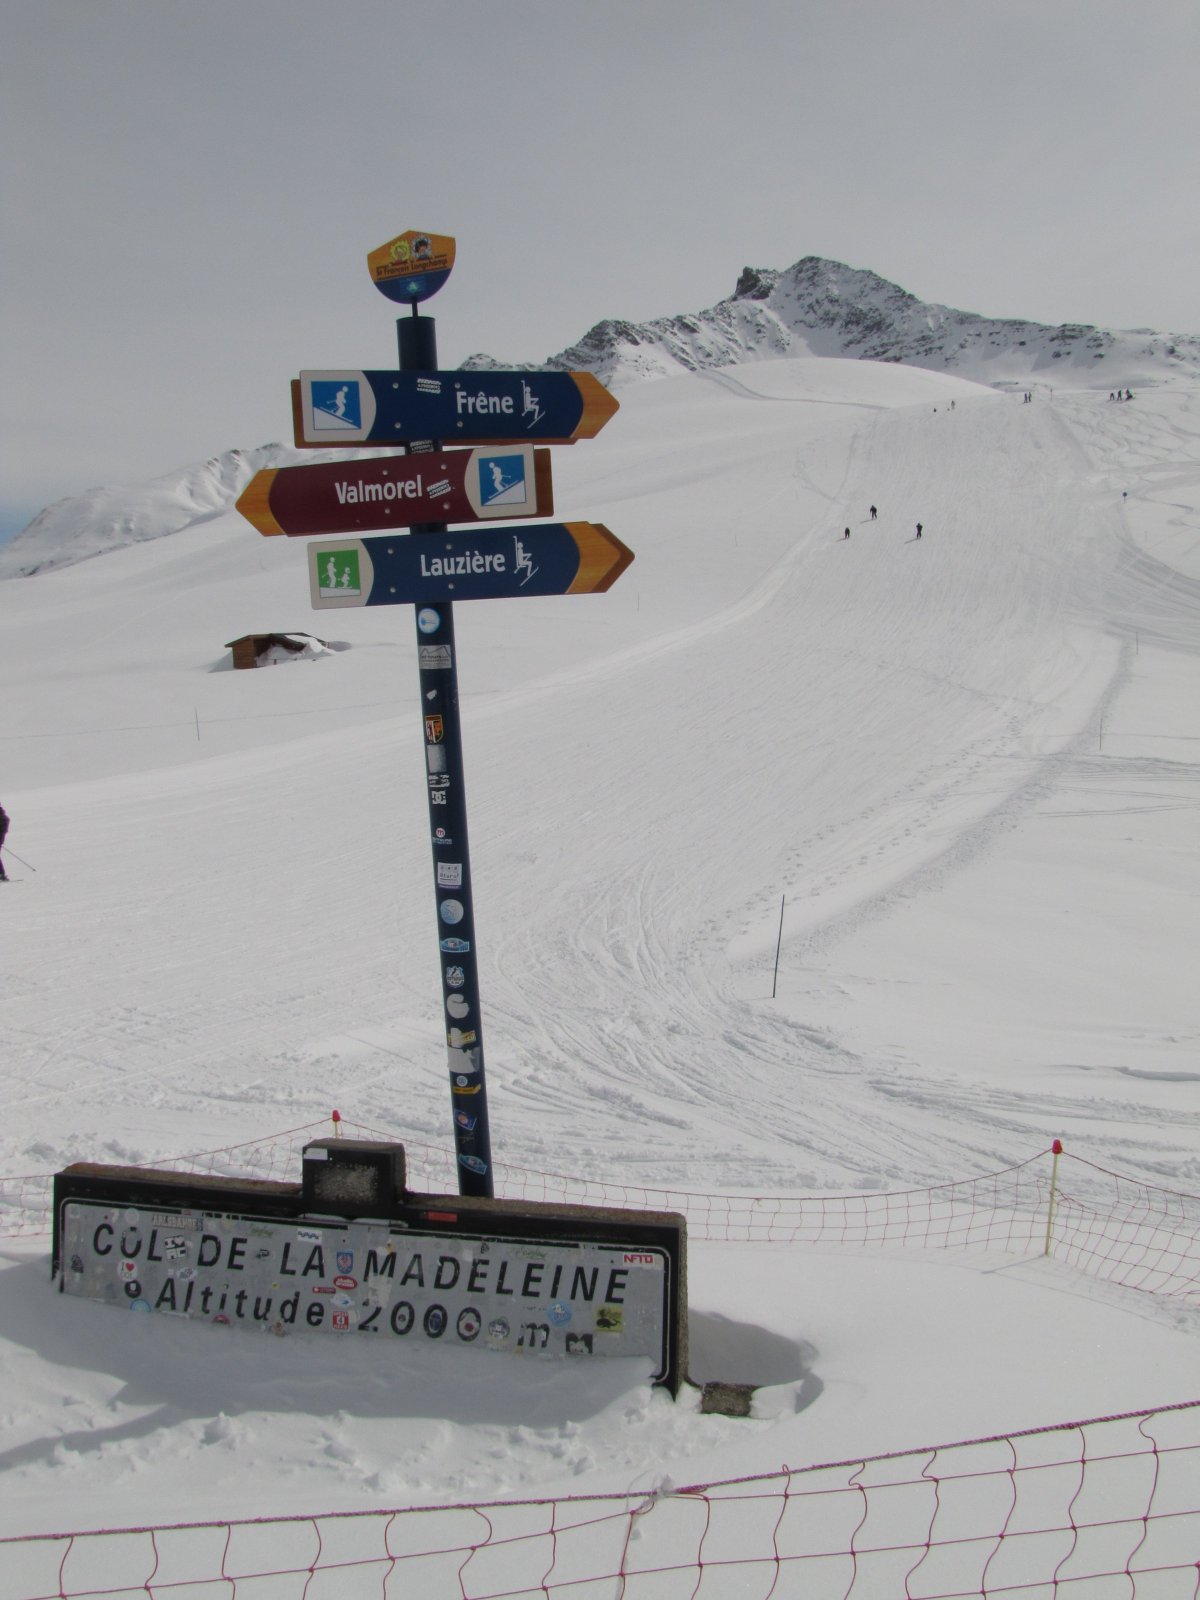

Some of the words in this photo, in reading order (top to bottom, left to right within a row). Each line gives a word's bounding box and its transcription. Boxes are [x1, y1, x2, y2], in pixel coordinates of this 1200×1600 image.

[456, 391, 514, 414] Frêne
[335, 475, 423, 505] Valmorel
[420, 550, 506, 577] Lauzière
[93, 1223, 163, 1262] COL
[197, 1233, 248, 1271] DE
[279, 1242, 326, 1278] LA
[363, 1248, 629, 1304] MADELEINE
[154, 1277, 325, 1327] Altitude
[358, 1297, 482, 1342] 2000
